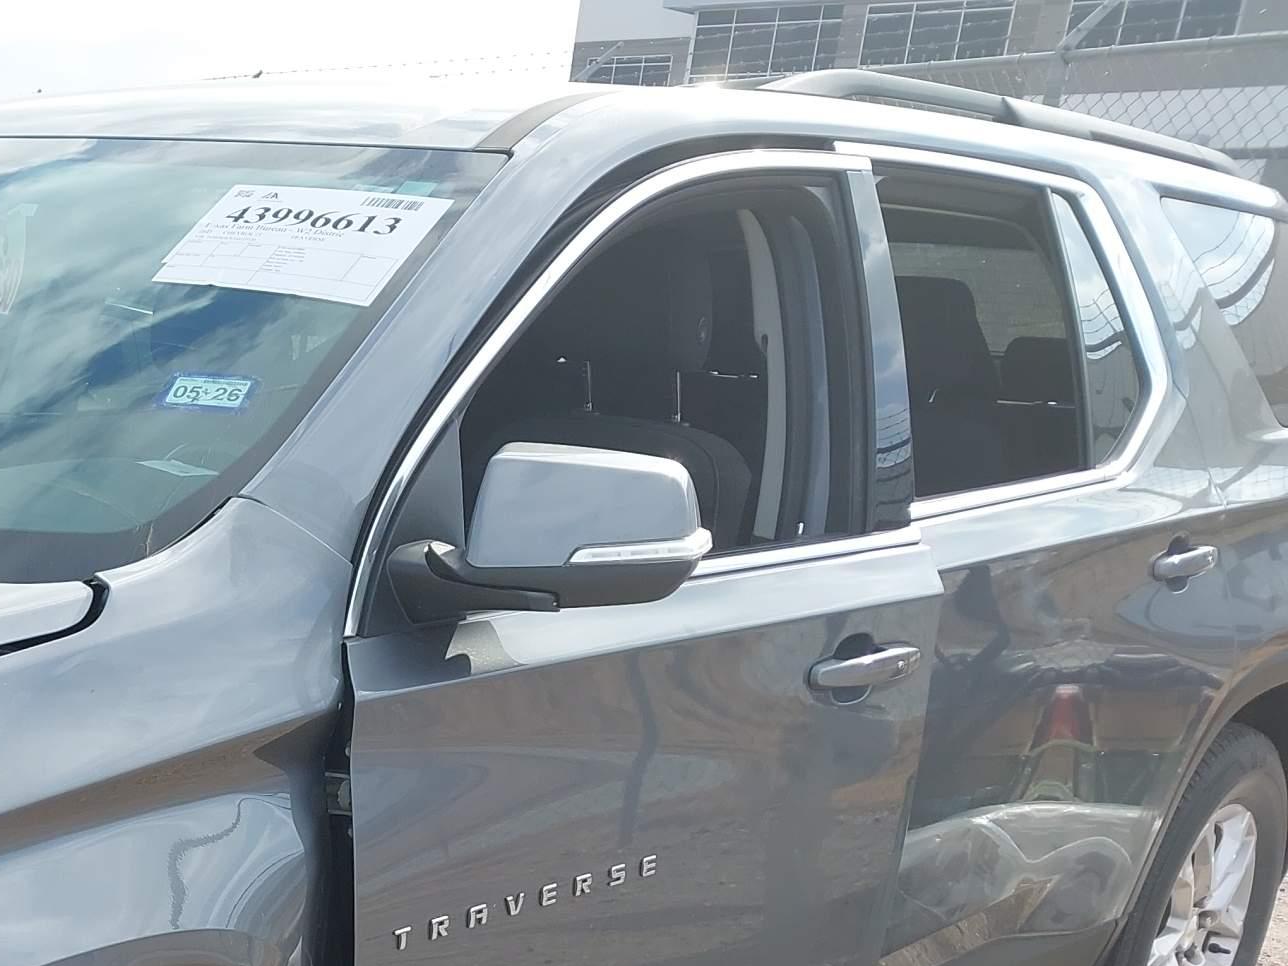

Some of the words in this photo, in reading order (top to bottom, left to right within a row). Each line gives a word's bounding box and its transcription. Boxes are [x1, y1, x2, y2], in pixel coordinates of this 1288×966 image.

[225, 206, 402, 235] 43996613
[211, 388, 243, 402] 26
[392, 854, 657, 950] TRAVERSE
